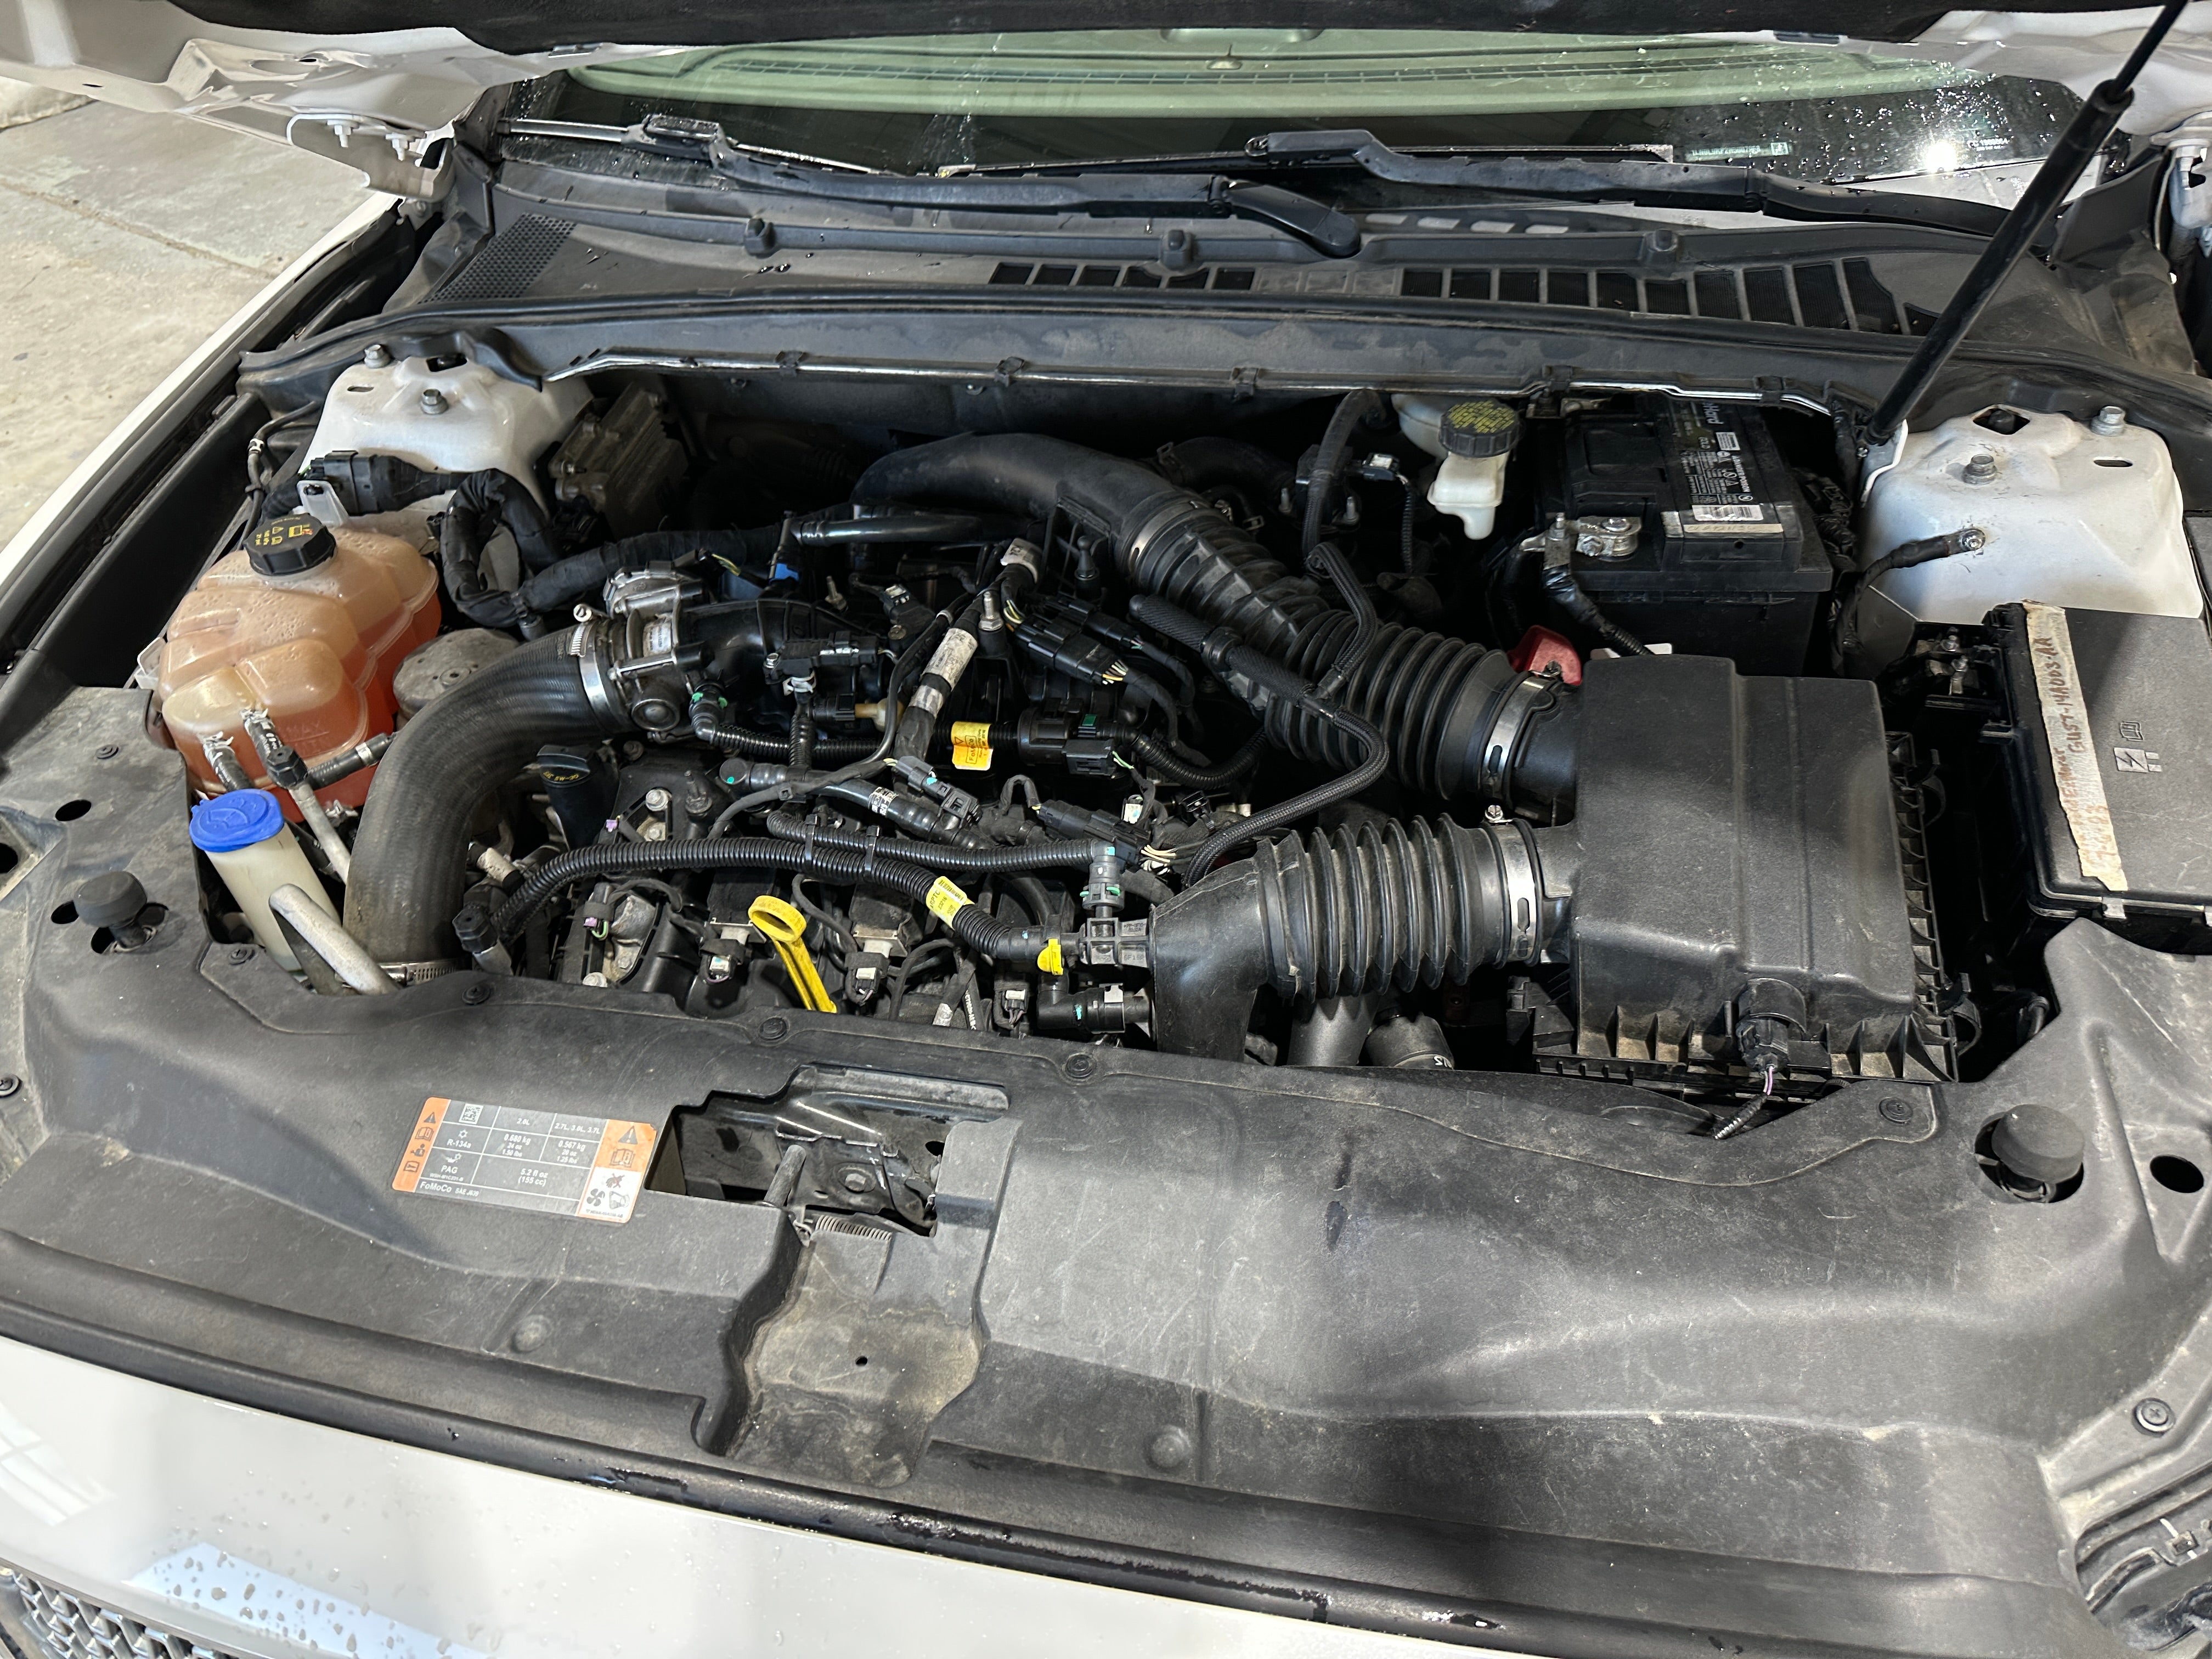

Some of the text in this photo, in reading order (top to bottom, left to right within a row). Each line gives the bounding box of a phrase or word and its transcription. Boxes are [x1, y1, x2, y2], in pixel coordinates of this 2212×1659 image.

[447, 1139, 471, 1148] R-134a
[522, 1136, 531, 1146] kg
[558, 1141, 586, 1152] 0.567 kg
[441, 1165, 458, 1173] PAG
[518, 1176, 534, 1184] (155
[420, 1181, 452, 1193] FoMoCo
